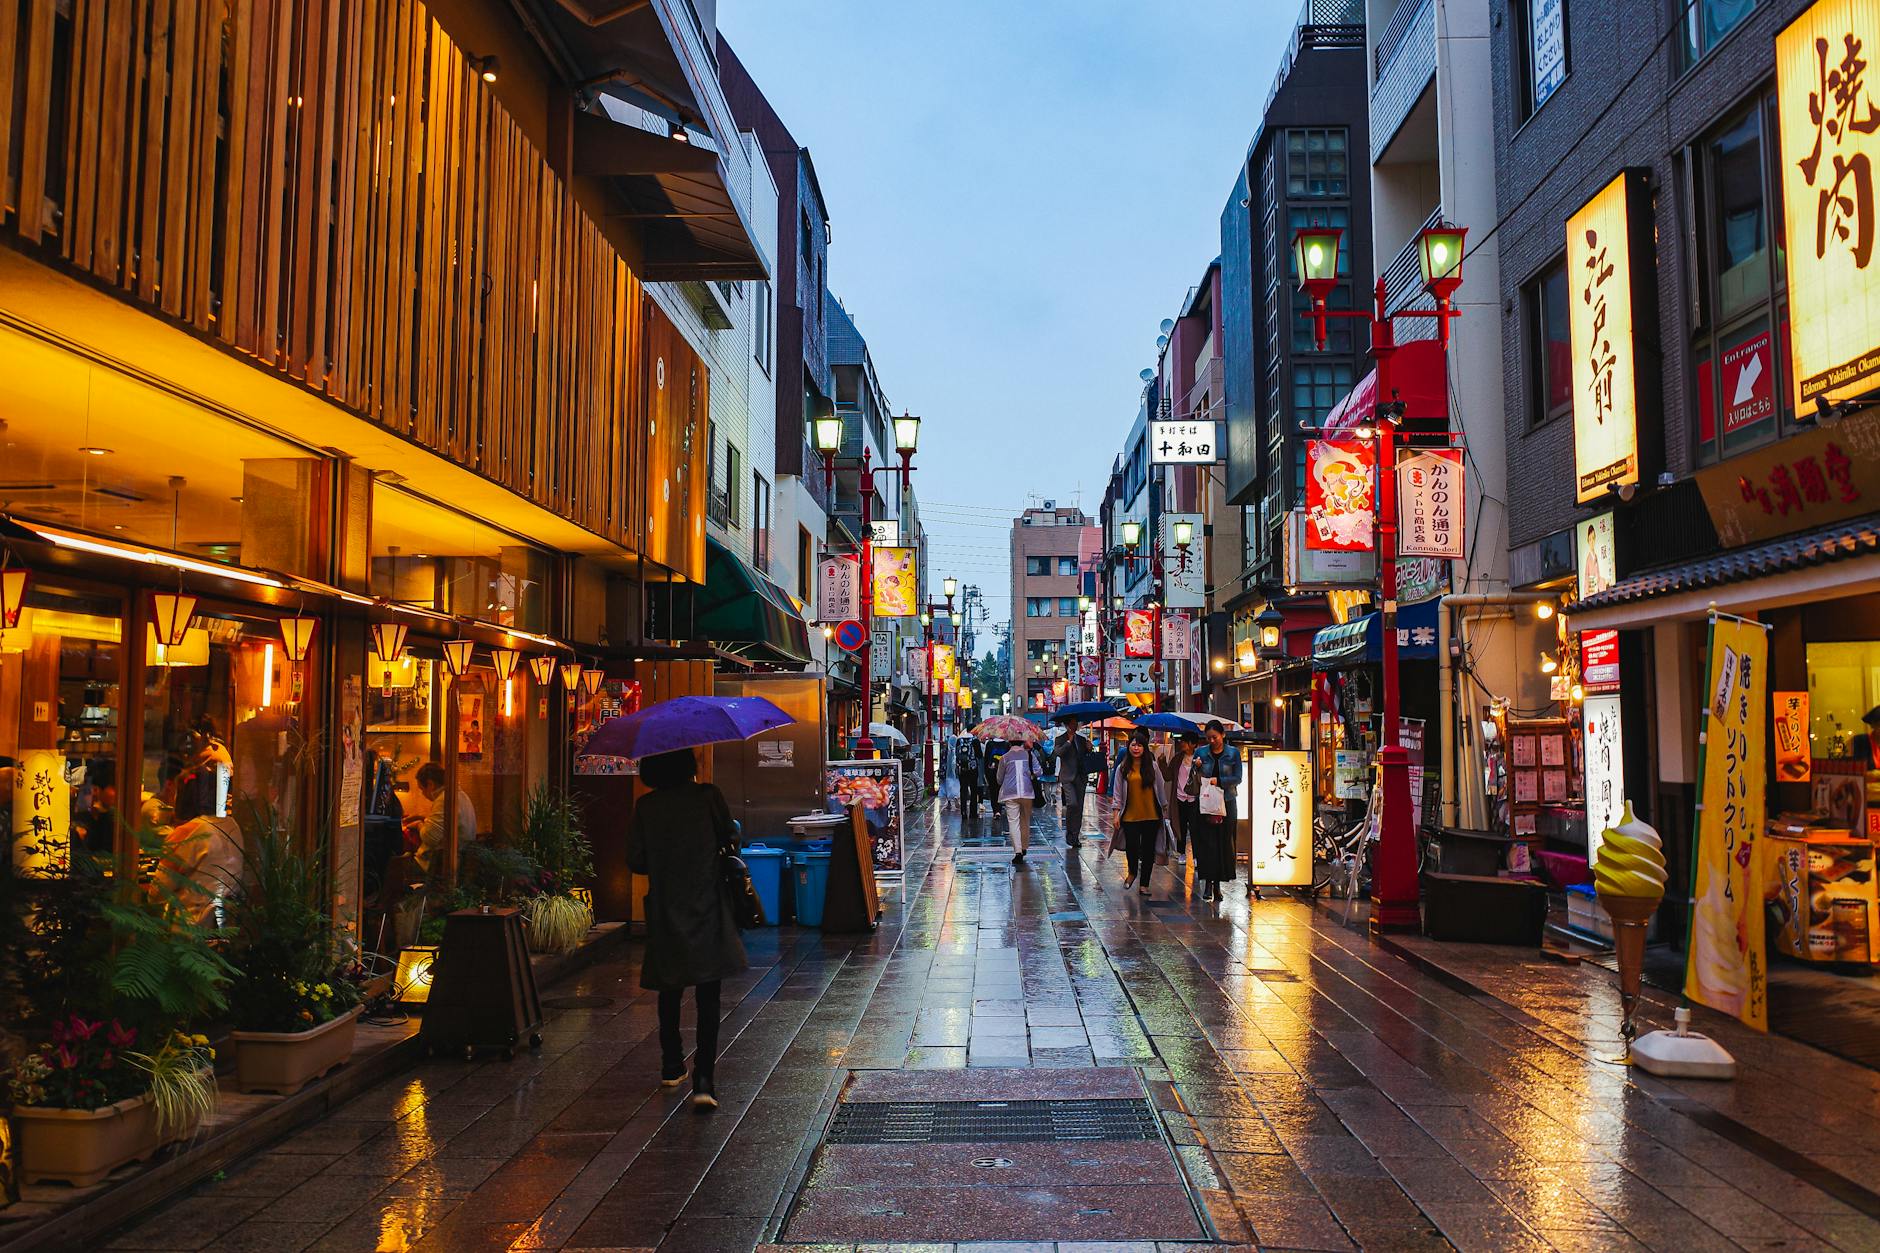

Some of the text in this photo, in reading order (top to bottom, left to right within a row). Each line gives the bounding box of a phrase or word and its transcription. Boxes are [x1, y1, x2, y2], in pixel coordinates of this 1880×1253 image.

[1797, 33, 1880, 270] 焼肉
[1584, 229, 1617, 426] 江戸前
[1724, 338, 1768, 366] Entrance
[1802, 378, 1828, 397] Edomae
[1828, 365, 1857, 386] Yakiniku
[1728, 397, 1771, 427] 入り口はこちら
[1158, 440, 1210, 457] 十和田
[1314, 509, 1330, 537] 浅草
[1414, 490, 1426, 543] メトロ商店会
[1431, 463, 1450, 546] かんのん通り
[1406, 544, 1458, 553] Kannon-dori
[840, 563, 851, 615] かんのん通り
[1269, 771, 1297, 862] 焼肉岡本
[1724, 727, 1737, 903] ソフトクリーム
